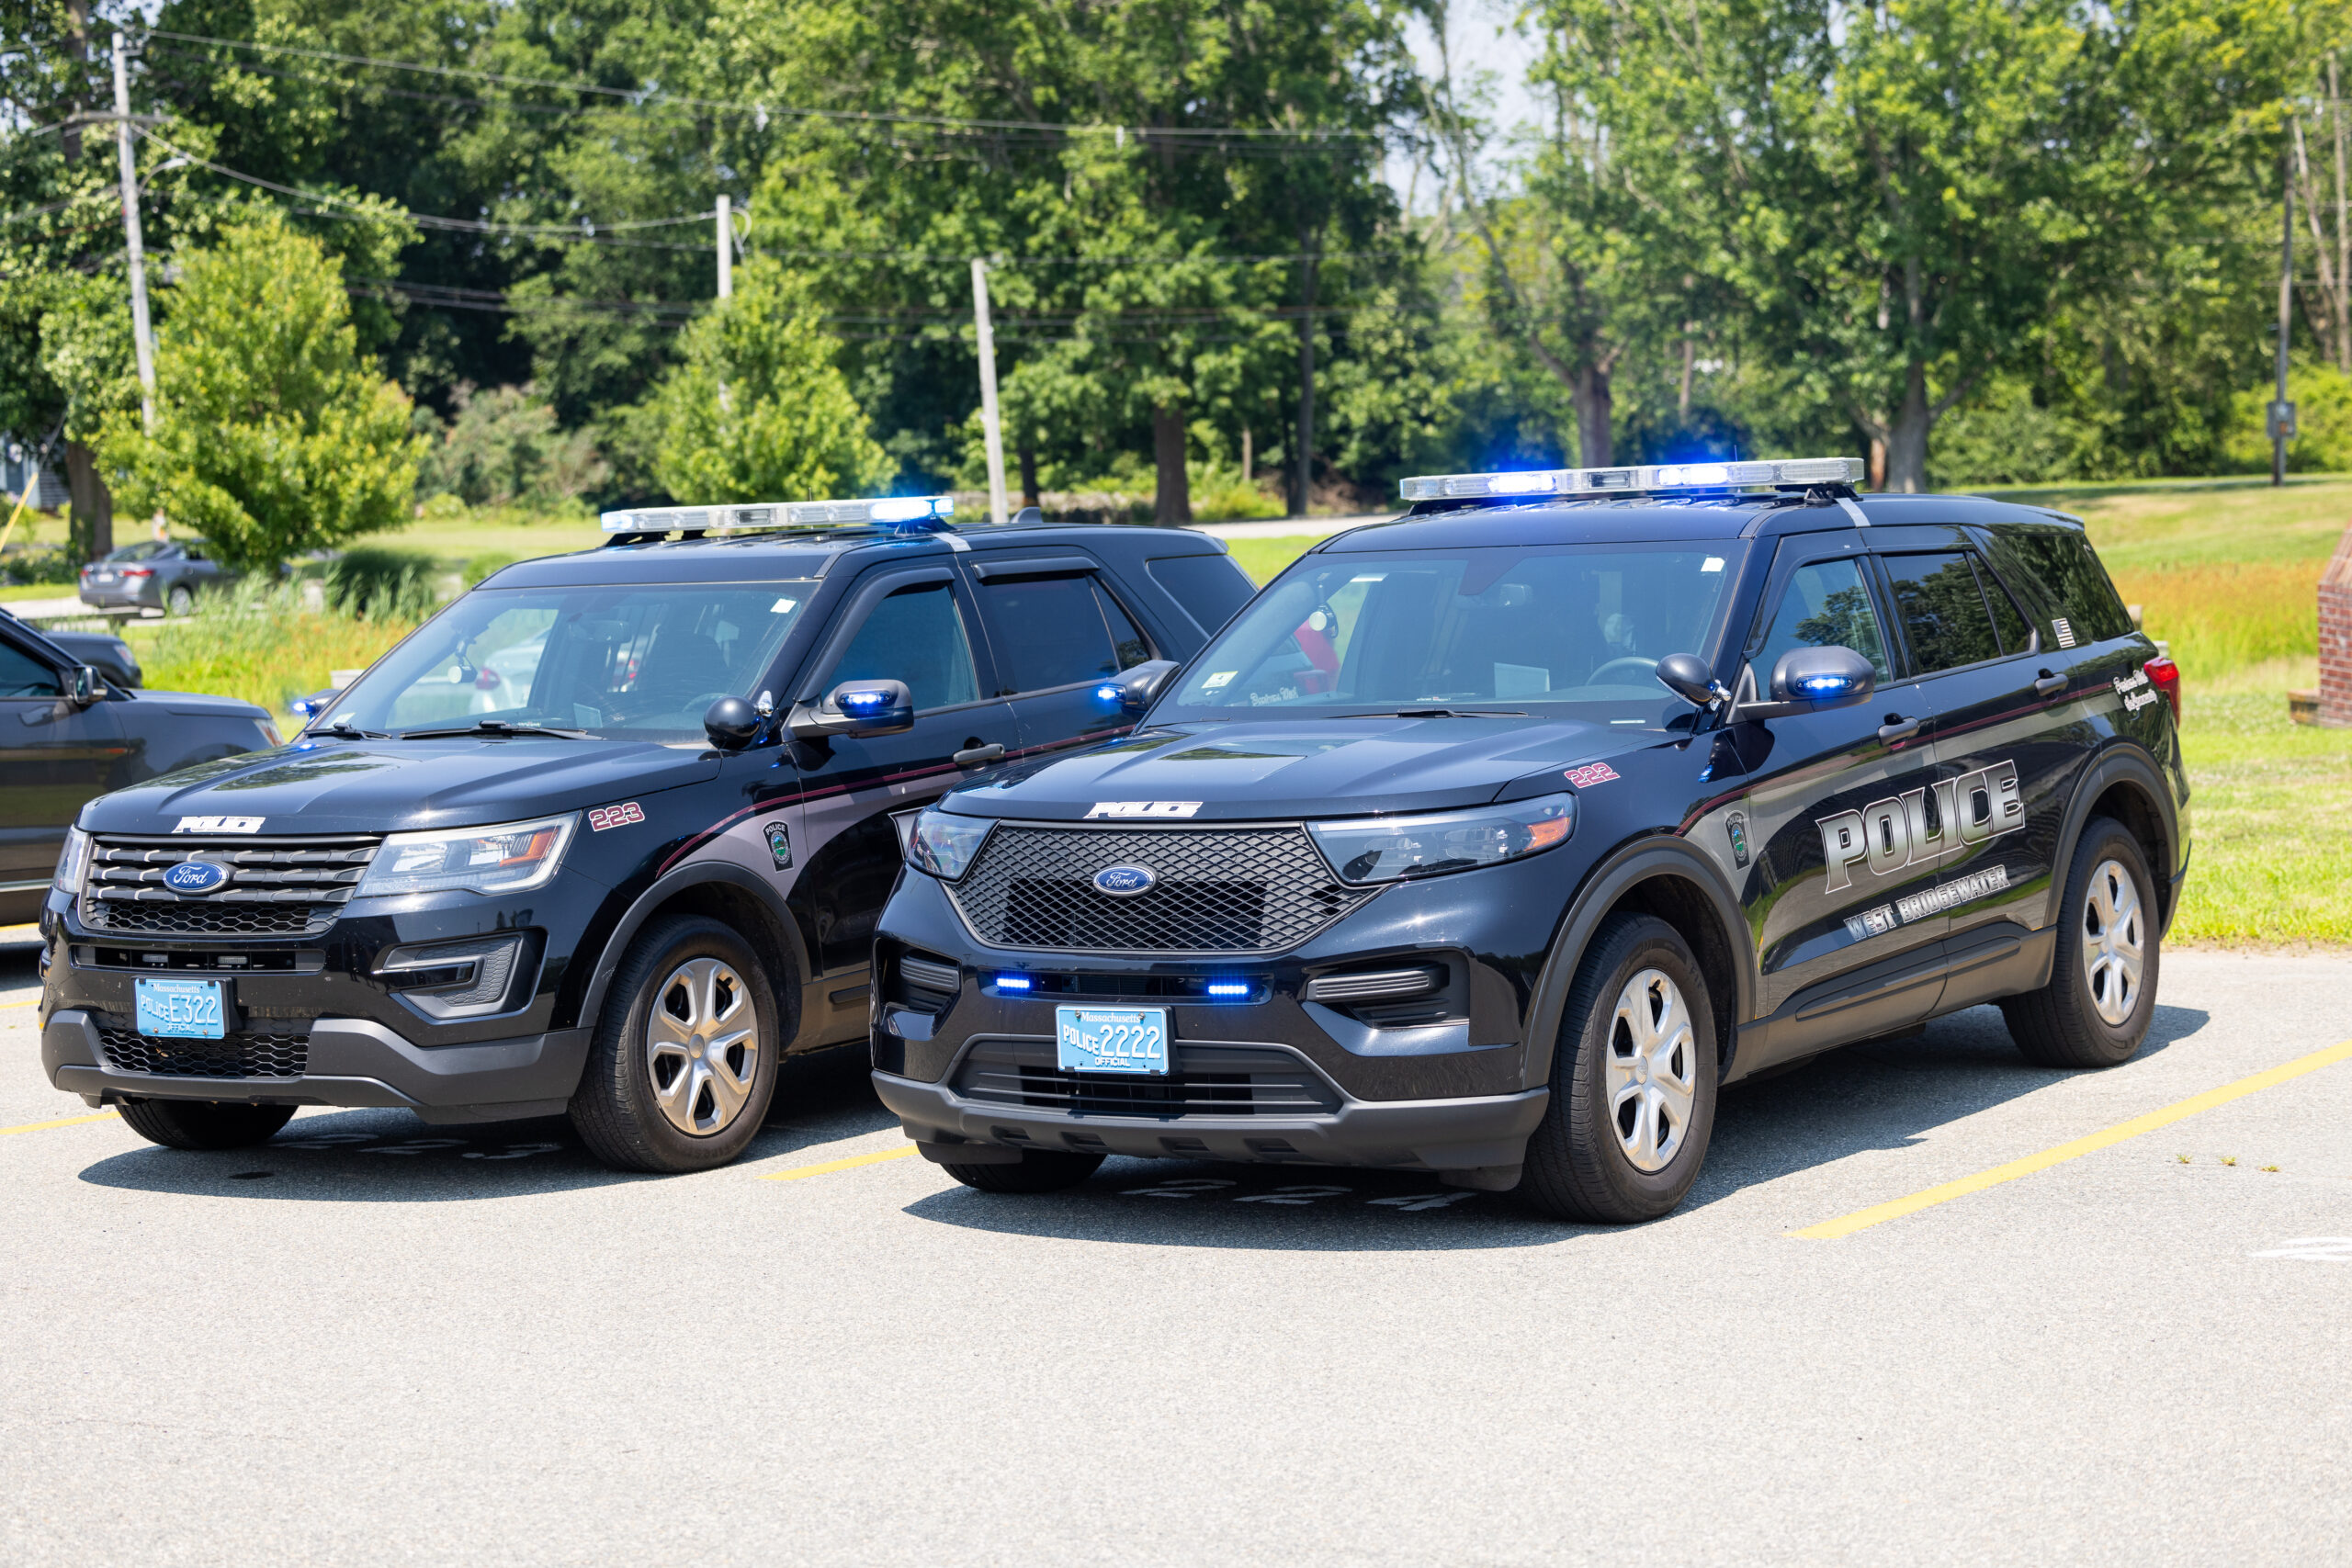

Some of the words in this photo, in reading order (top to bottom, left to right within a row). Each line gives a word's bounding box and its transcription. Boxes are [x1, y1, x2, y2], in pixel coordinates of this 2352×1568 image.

[1564, 762, 1621, 788] 222
[589, 802, 645, 832] 223
[1082, 801, 1204, 818] POLICE
[171, 816, 266, 834] POLICE
[765, 823, 786, 835] POLICE
[1815, 759, 2025, 895] POLICE
[173, 865, 209, 884] Ford
[1105, 871, 1137, 888] Ford
[1844, 904, 1896, 942] WEST
[1895, 864, 2011, 923] BRIDGEWATER
[153, 983, 200, 993] Massachusetts
[141, 994, 170, 1022] POLICE
[168, 994, 219, 1026] E322
[1080, 1011, 1140, 1023] Massachusetts
[1063, 1024, 1100, 1055] POLICE
[1099, 1024, 1161, 1059] 2222
[1094, 1057, 1131, 1067] OFFICIAL
